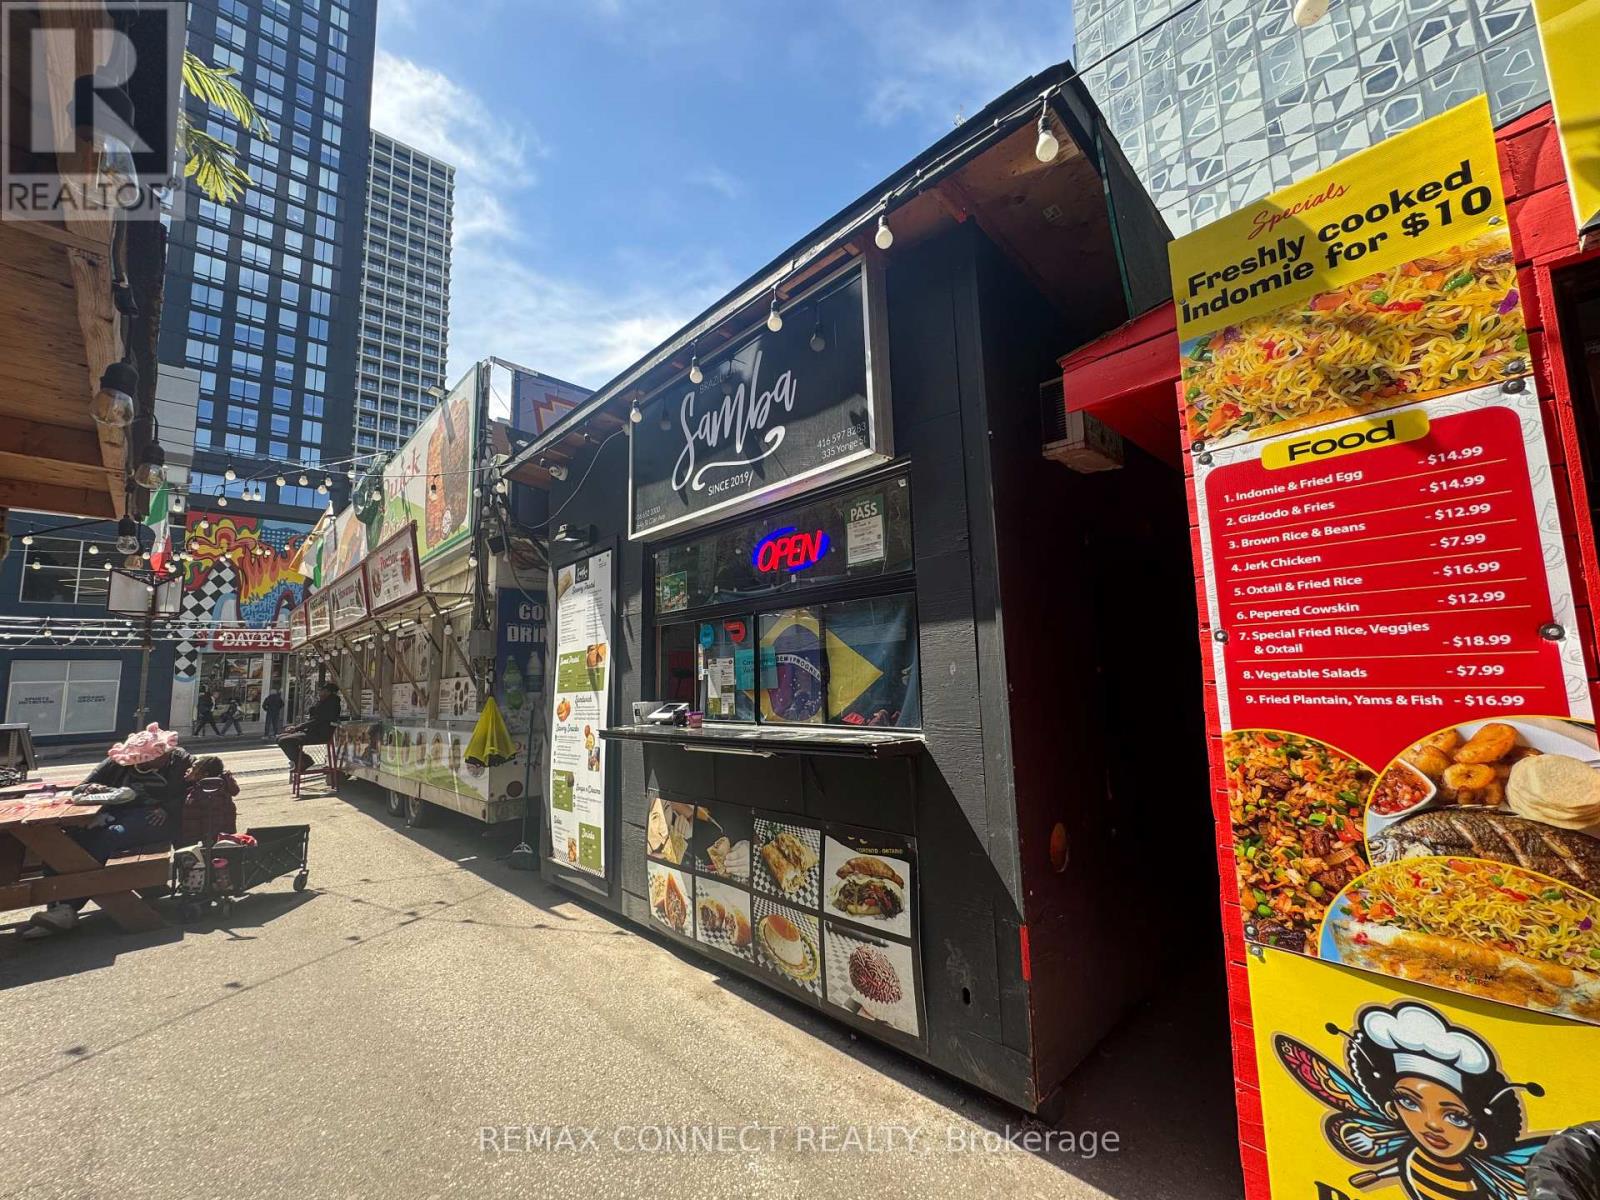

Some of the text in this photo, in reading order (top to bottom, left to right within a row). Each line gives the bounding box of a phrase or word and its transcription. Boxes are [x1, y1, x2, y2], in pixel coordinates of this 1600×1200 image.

[1247, 183, 1351, 240] Specials
[1187, 159, 1473, 298] Freshly cooked
[1182, 186, 1493, 324] Indomie for $10
[817, 436, 831, 449] 416
[832, 430, 846, 444] 597
[836, 439, 858, 453] Yonge
[1288, 419, 1396, 462] Food
[708, 471, 749, 496] SINCE 2019
[1224, 494, 1234, 503] 1.
[1235, 485, 1286, 501] Indomie
[1287, 481, 1298, 492] &
[1299, 473, 1334, 489] Fried
[1335, 470, 1363, 483] Egg
[850, 501, 878, 521] PASS
[1226, 517, 1237, 527] 2.
[1238, 509, 1290, 525] Gizdodo
[1291, 505, 1302, 516] &
[1303, 501, 1336, 514] Fries
[1228, 540, 1240, 549] 3.
[1241, 535, 1280, 548] Brown
[1282, 530, 1309, 542] Rice
[1310, 527, 1322, 538] &
[1323, 522, 1366, 536] Beans
[757, 530, 823, 572] OPEN
[1231, 563, 1242, 573] 4.
[1243, 560, 1269, 572] Jerk
[1270, 554, 1322, 568] Chicken
[1234, 587, 1245, 597] 5.
[1246, 582, 1283, 595] Oxtail
[1284, 580, 1296, 592] &
[1297, 577, 1331, 590] Fried
[1333, 575, 1363, 587] Rice
[1236, 611, 1248, 620] 6.
[1249, 606, 1301, 620] Pepered
[1302, 602, 1360, 615] Cowskin
[222, 631, 286, 648] DAVE'S
[1239, 621, 1430, 642] 7. Special Fried Rice, Veggies
[1254, 645, 1264, 655] &
[1265, 643, 1304, 654] Oxtail
[1243, 670, 1255, 680] 8.
[1255, 668, 1320, 681] Vegetable
[1321, 667, 1368, 679] Salads
[1245, 694, 1258, 705] 9.
[1258, 694, 1291, 705] Fried
[1292, 694, 1353, 706] Plantain,
[1353, 695, 1393, 705] Yams
[1395, 695, 1409, 705] &
[1410, 694, 1444, 706] Fish
